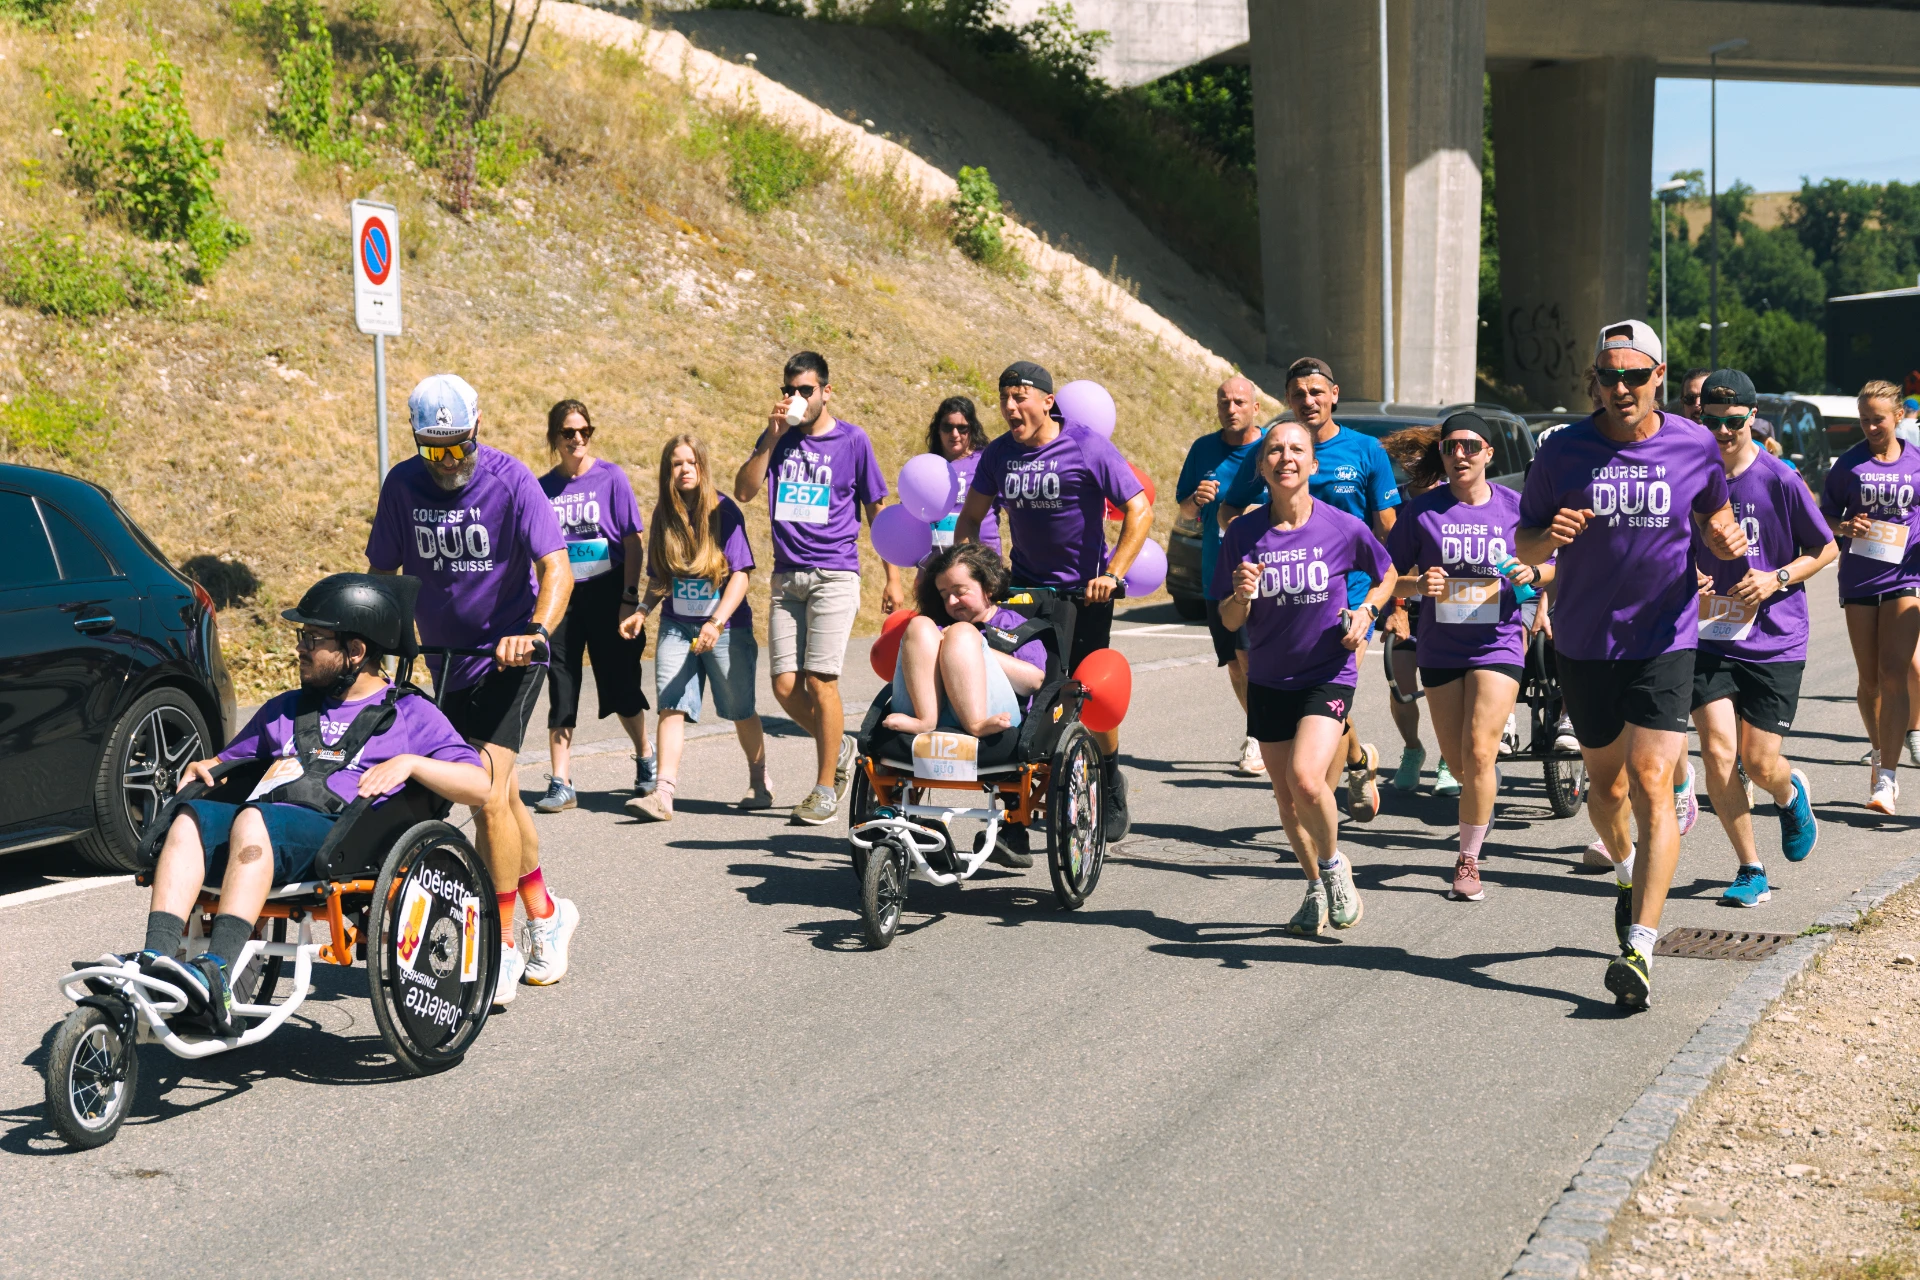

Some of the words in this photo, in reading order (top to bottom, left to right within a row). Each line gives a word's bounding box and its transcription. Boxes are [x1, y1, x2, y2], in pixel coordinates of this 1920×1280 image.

[783, 448, 820, 462] COURSE
[1007, 460, 1045, 471] COURSE
[1592, 466, 1648, 480] COURSE
[1860, 472, 1899, 482] COURSE
[1004, 473, 1060, 499] DUO
[784, 485, 823, 505] 267
[1593, 481, 1671, 516] DUO
[1861, 484, 1914, 507] DUO
[1030, 500, 1062, 509] SUISSE
[412, 508, 465, 523] COURSE
[1628, 516, 1670, 528] SUISSE
[1441, 524, 1488, 535] COURSE
[414, 523, 491, 558] DUO
[1258, 548, 1307, 564] COURSE
[1441, 537, 1507, 566] DUO
[450, 559, 494, 572] SUISSE
[1471, 565, 1500, 576] SUISS
[1260, 560, 1329, 597] DUO
[677, 581, 713, 599] 264
[1448, 581, 1487, 602] 106
[1293, 592, 1329, 605] SUISSE
[1709, 598, 1746, 621] 105
[1712, 626, 1732, 635] DUO
[930, 735, 959, 758] 112
[933, 764, 954, 774] DUO
[405, 986, 462, 1034] Joëlette
